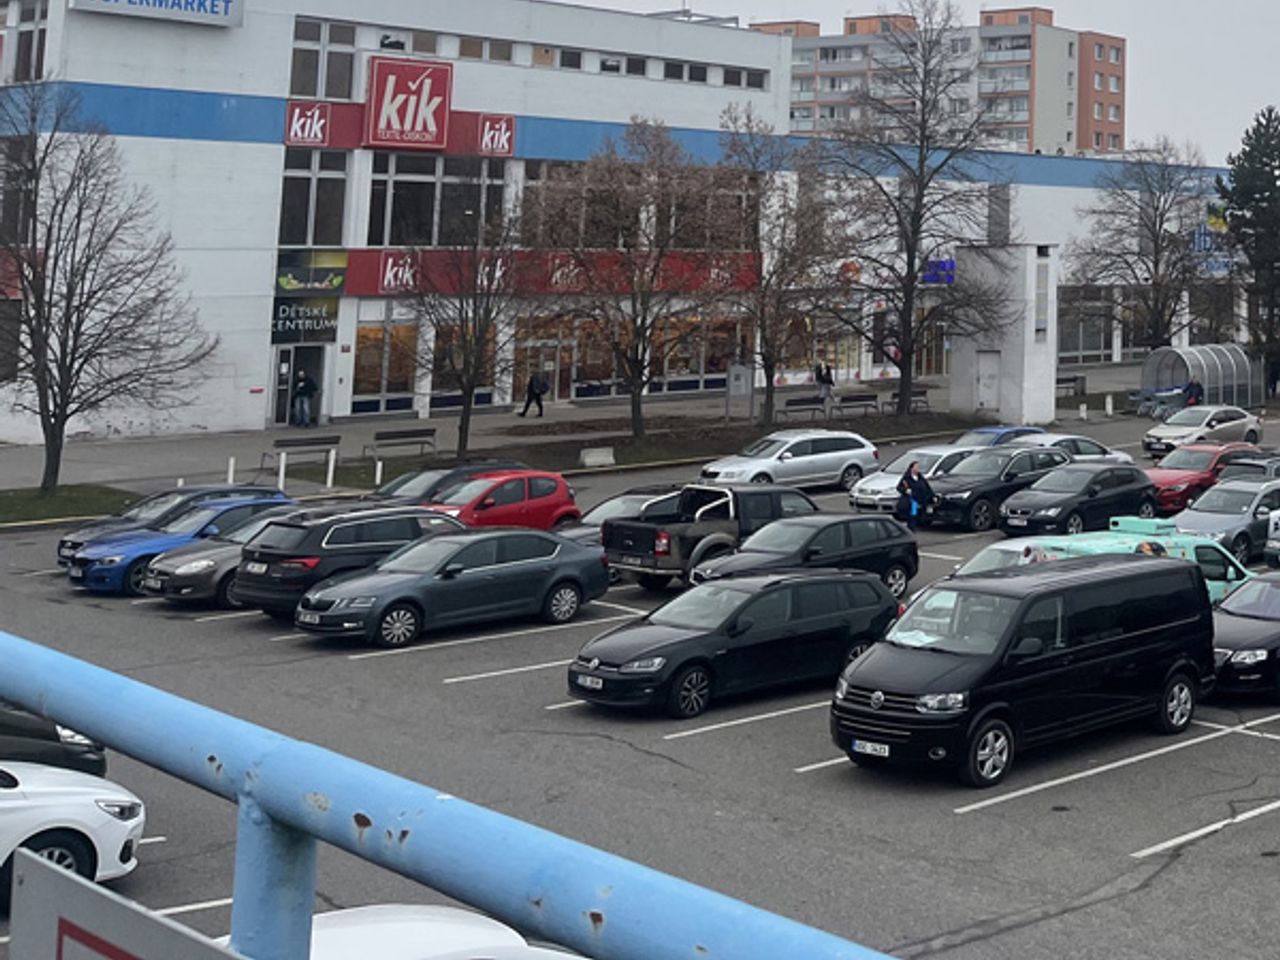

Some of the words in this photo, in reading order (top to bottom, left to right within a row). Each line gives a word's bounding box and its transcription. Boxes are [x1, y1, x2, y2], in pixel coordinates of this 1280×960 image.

[378, 69, 443, 135] kik
[290, 104, 326, 140] kik
[481, 118, 512, 153] kik
